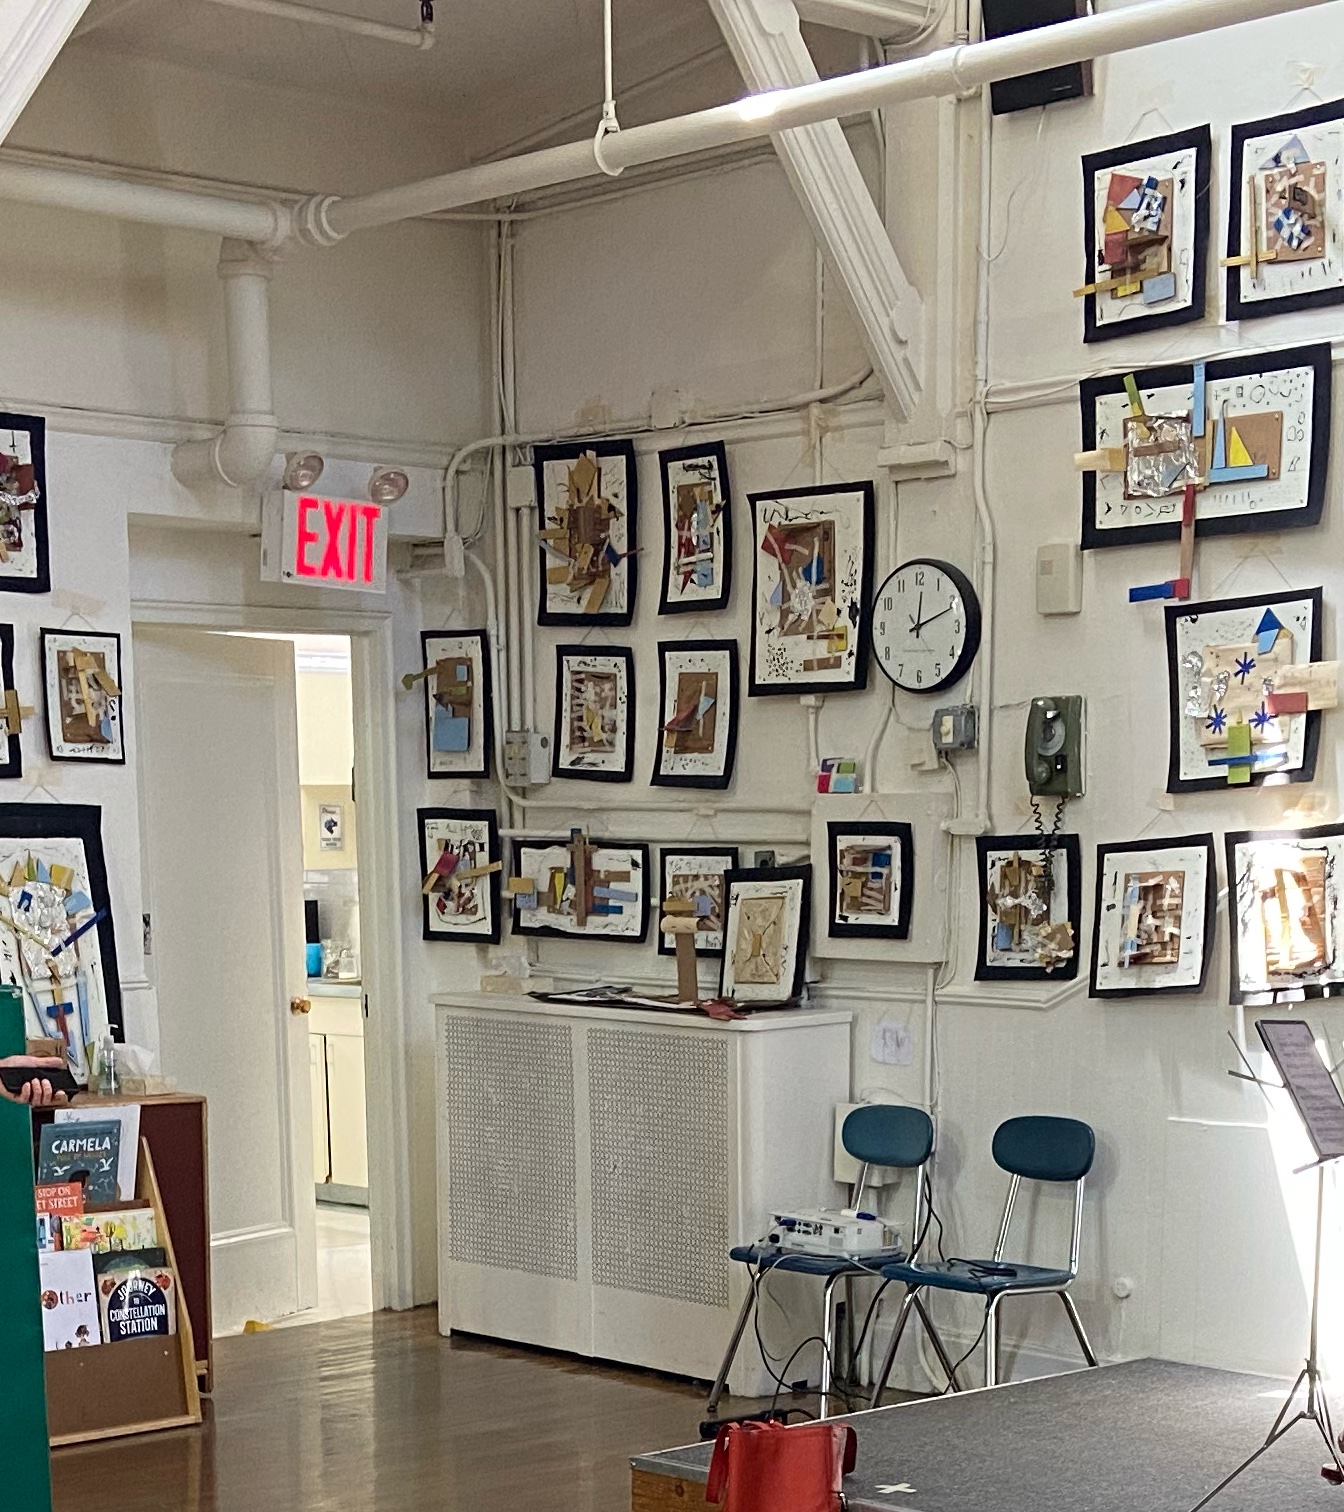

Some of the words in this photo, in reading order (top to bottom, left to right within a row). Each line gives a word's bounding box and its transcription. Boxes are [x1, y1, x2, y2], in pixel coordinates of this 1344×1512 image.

[296, 496, 381, 583] EXIT
[915, 572, 924, 585] 12
[936, 578, 940, 592] 1
[897, 579, 905, 593] 11
[883, 597, 893, 611] 10
[880, 622, 885, 635] 9
[954, 620, 960, 634] 3
[884, 646, 890, 660] 8
[949, 645, 955, 660] 4
[898, 664, 904, 677] 7
[917, 670, 922, 683] 6
[935, 663, 941, 676] 5
[51, 1136, 111, 1154] CARMELA
[38, 1187, 56, 1198] STOP
[57, 1185, 71, 1196] ON
[48, 1196, 79, 1209] STREET
[117, 1279, 157, 1301] JOURNEY
[109, 1303, 166, 1322] CONSTELLATION
[119, 1316, 158, 1335] STATION
